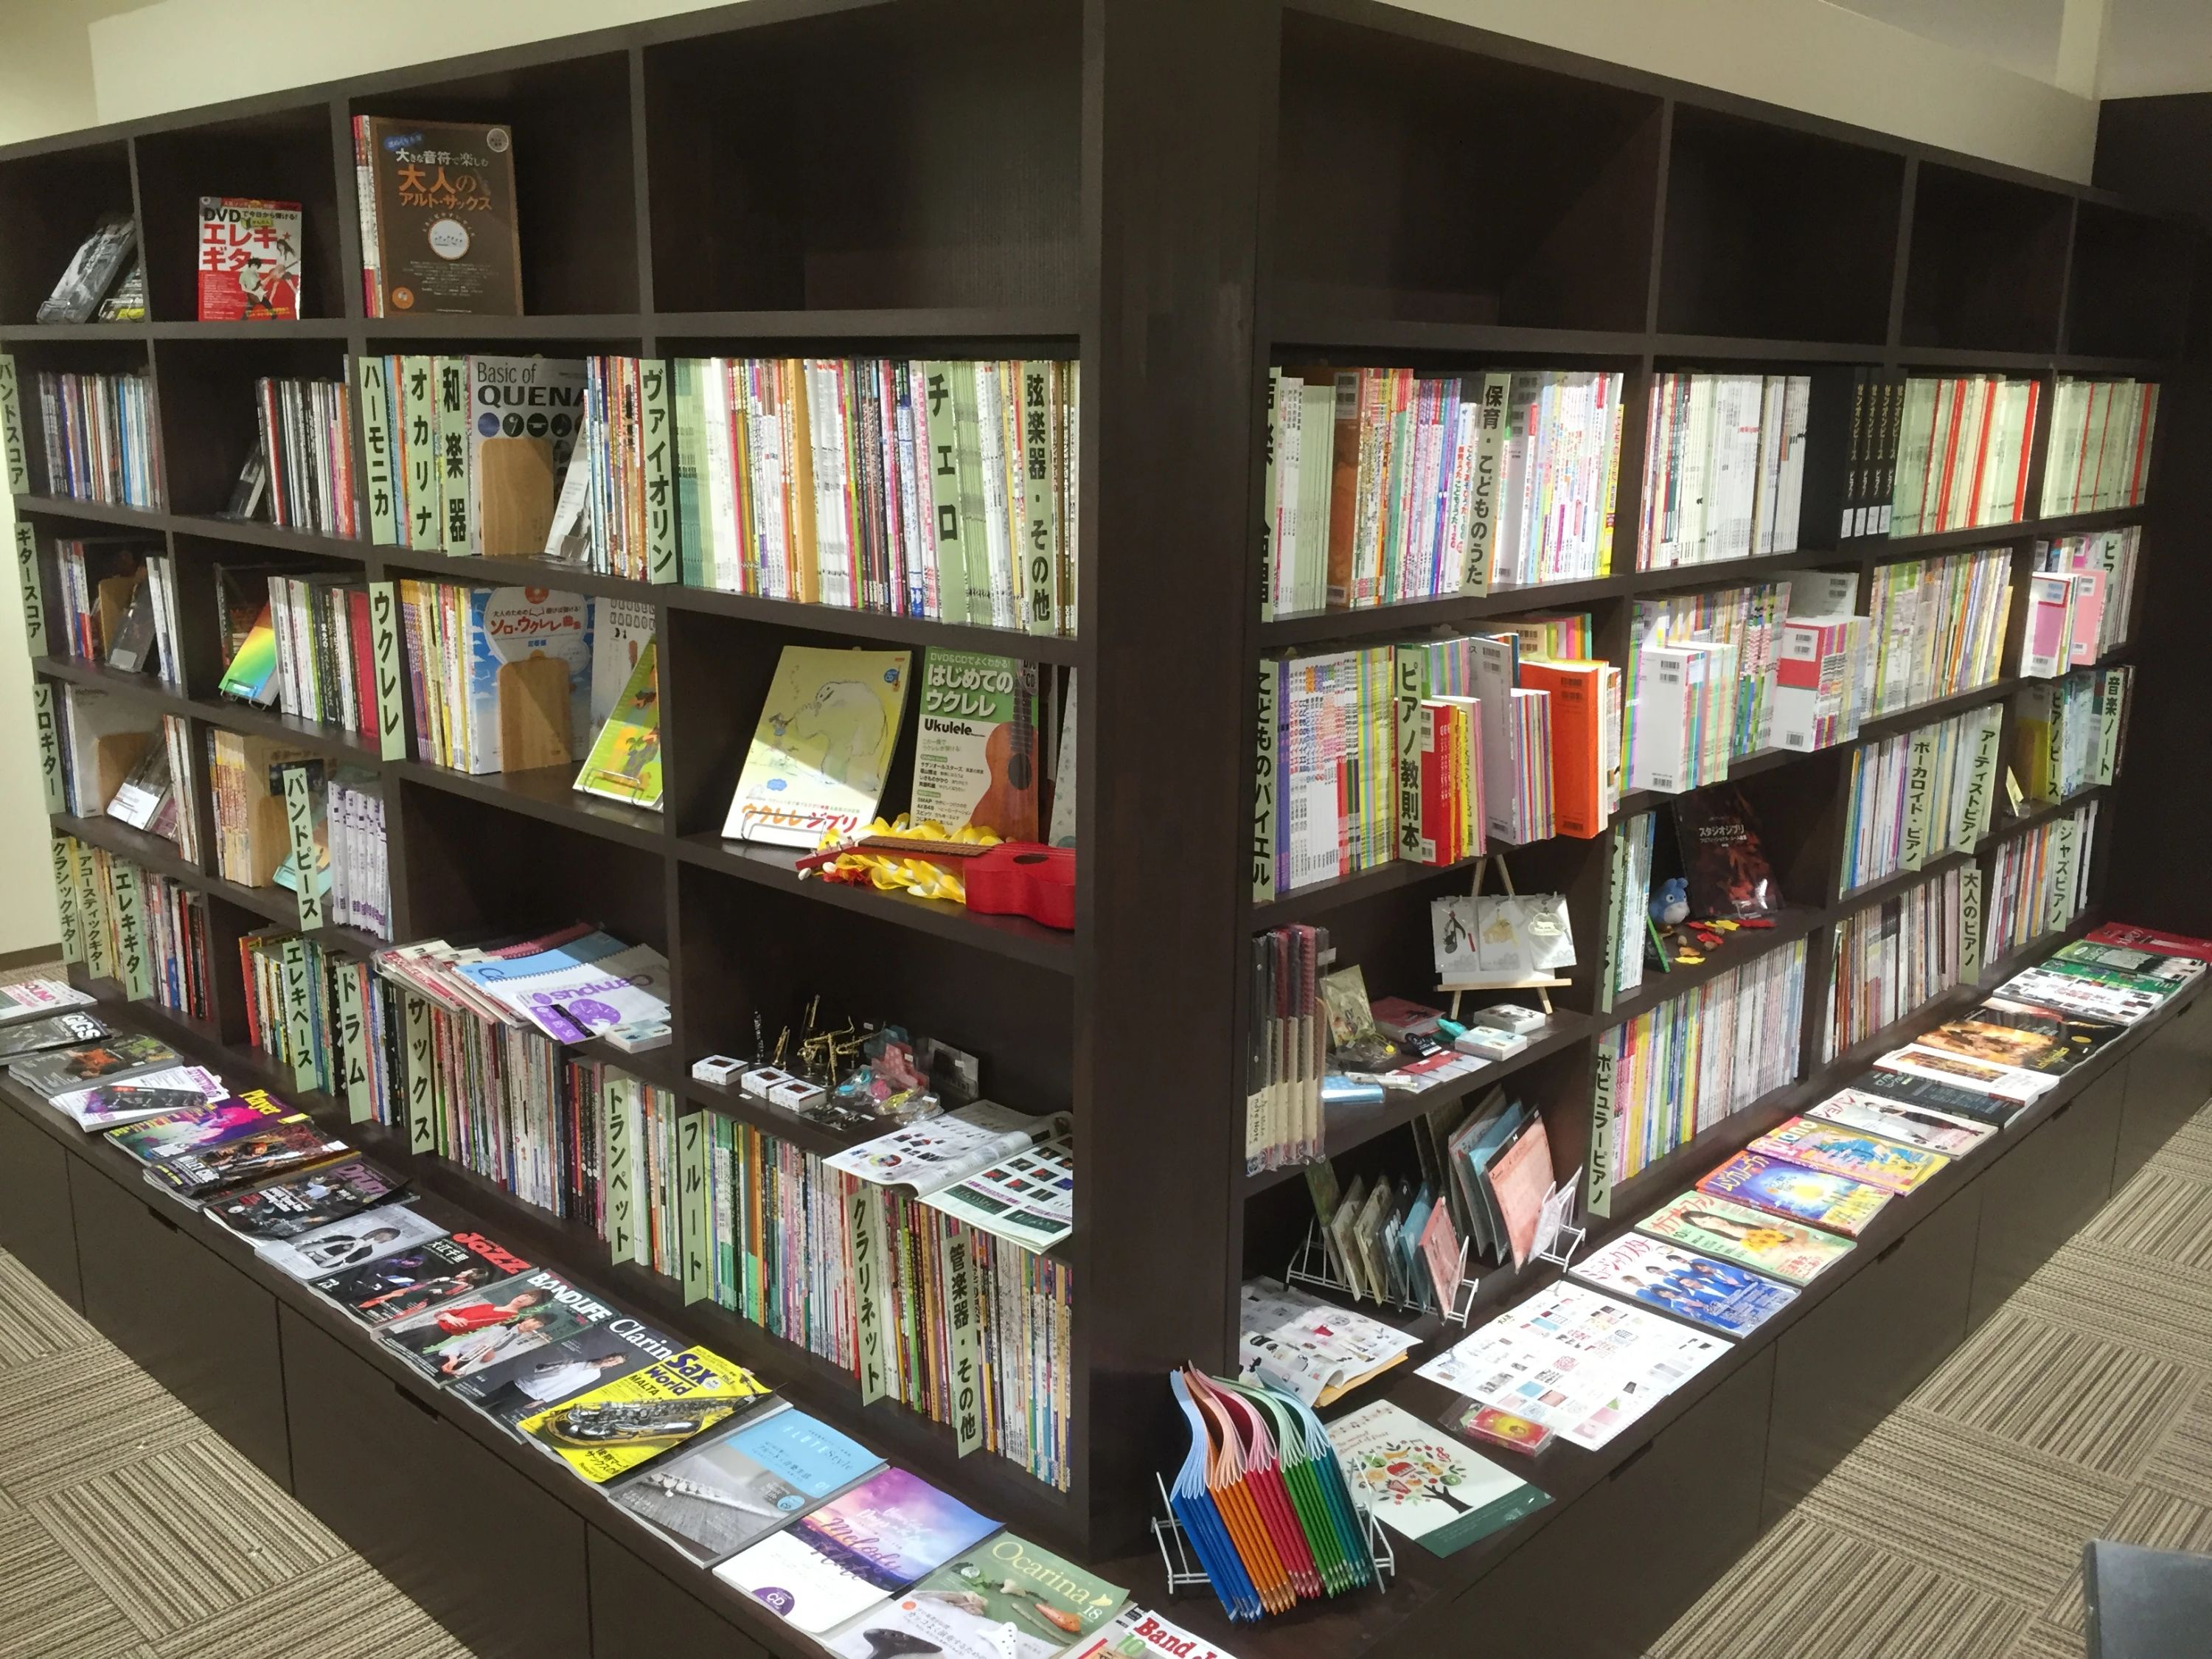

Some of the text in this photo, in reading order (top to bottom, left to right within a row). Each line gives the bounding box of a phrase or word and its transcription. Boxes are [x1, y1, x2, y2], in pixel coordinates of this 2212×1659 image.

[395, 148, 489, 167] 大きな音符で楽しむ
[397, 164, 476, 194] 大人の
[399, 192, 493, 211] アルト・サックス
[203, 223, 277, 248] エレキ
[203, 246, 276, 271] ギター
[478, 362, 537, 384] Basic of
[364, 365, 389, 516] ハーモニカ
[411, 369, 432, 535] オカリナ
[442, 366, 467, 542] 和楽器
[643, 369, 672, 574] ヴァイオリン
[928, 373, 959, 541] チェロ
[1467, 384, 1503, 585] 保育・こどものうた
[1026, 374, 1051, 622] 弦楽器・その他
[17, 528, 42, 639] ギタースコア
[374, 591, 400, 737] ウクレレ
[926, 689, 996, 717] ウクレレ
[928, 664, 1013, 694] はじめての
[931, 653, 1010, 668] DVD&CDでよくわかる!
[35, 688, 57, 796] ソロギター
[924, 718, 973, 736] Ukulele
[1253, 671, 1273, 887] こどものバイエル
[1401, 661, 1419, 852] ピアノ教則本
[2101, 675, 2121, 776] 音楽ノート
[1699, 824, 1745, 837] スタジオジブリ
[1906, 741, 1930, 862] ボーカロイド・ピアノ
[1959, 729, 1995, 845] アーティストピアノ
[52, 841, 75, 956] クラシックギター
[287, 773, 318, 919] バンドピース
[2051, 825, 2074, 924] ジャズピアノ
[79, 856, 103, 972] アコースティックギター
[114, 873, 140, 993] エレキギター
[1964, 872, 1979, 967] 大人のピアノ
[287, 947, 313, 1068] エレキベース
[342, 972, 366, 1085] ドラム
[549, 974, 655, 1000] Campus
[238, 1089, 282, 1115] Player
[408, 998, 430, 1144] サックス
[609, 1088, 630, 1252] トランペット
[1593, 1052, 1612, 1204] ポピュラーピアノ
[431, 1241, 470, 1263] 大江千里
[684, 1121, 702, 1282] フルート
[853, 1198, 880, 1394] クラリネット
[949, 1244, 977, 1441] 管楽器・その他
[628, 1374, 660, 1394] MALTA
[644, 1366, 694, 1397] World
[666, 1354, 718, 1385] Sax
[822, 1518, 901, 1571] Melody
[991, 1541, 1090, 1605] Ocarina
[766, 1592, 785, 1607] CD
[1082, 1604, 1103, 1621] 18
[1133, 1617, 1197, 1659] Band
